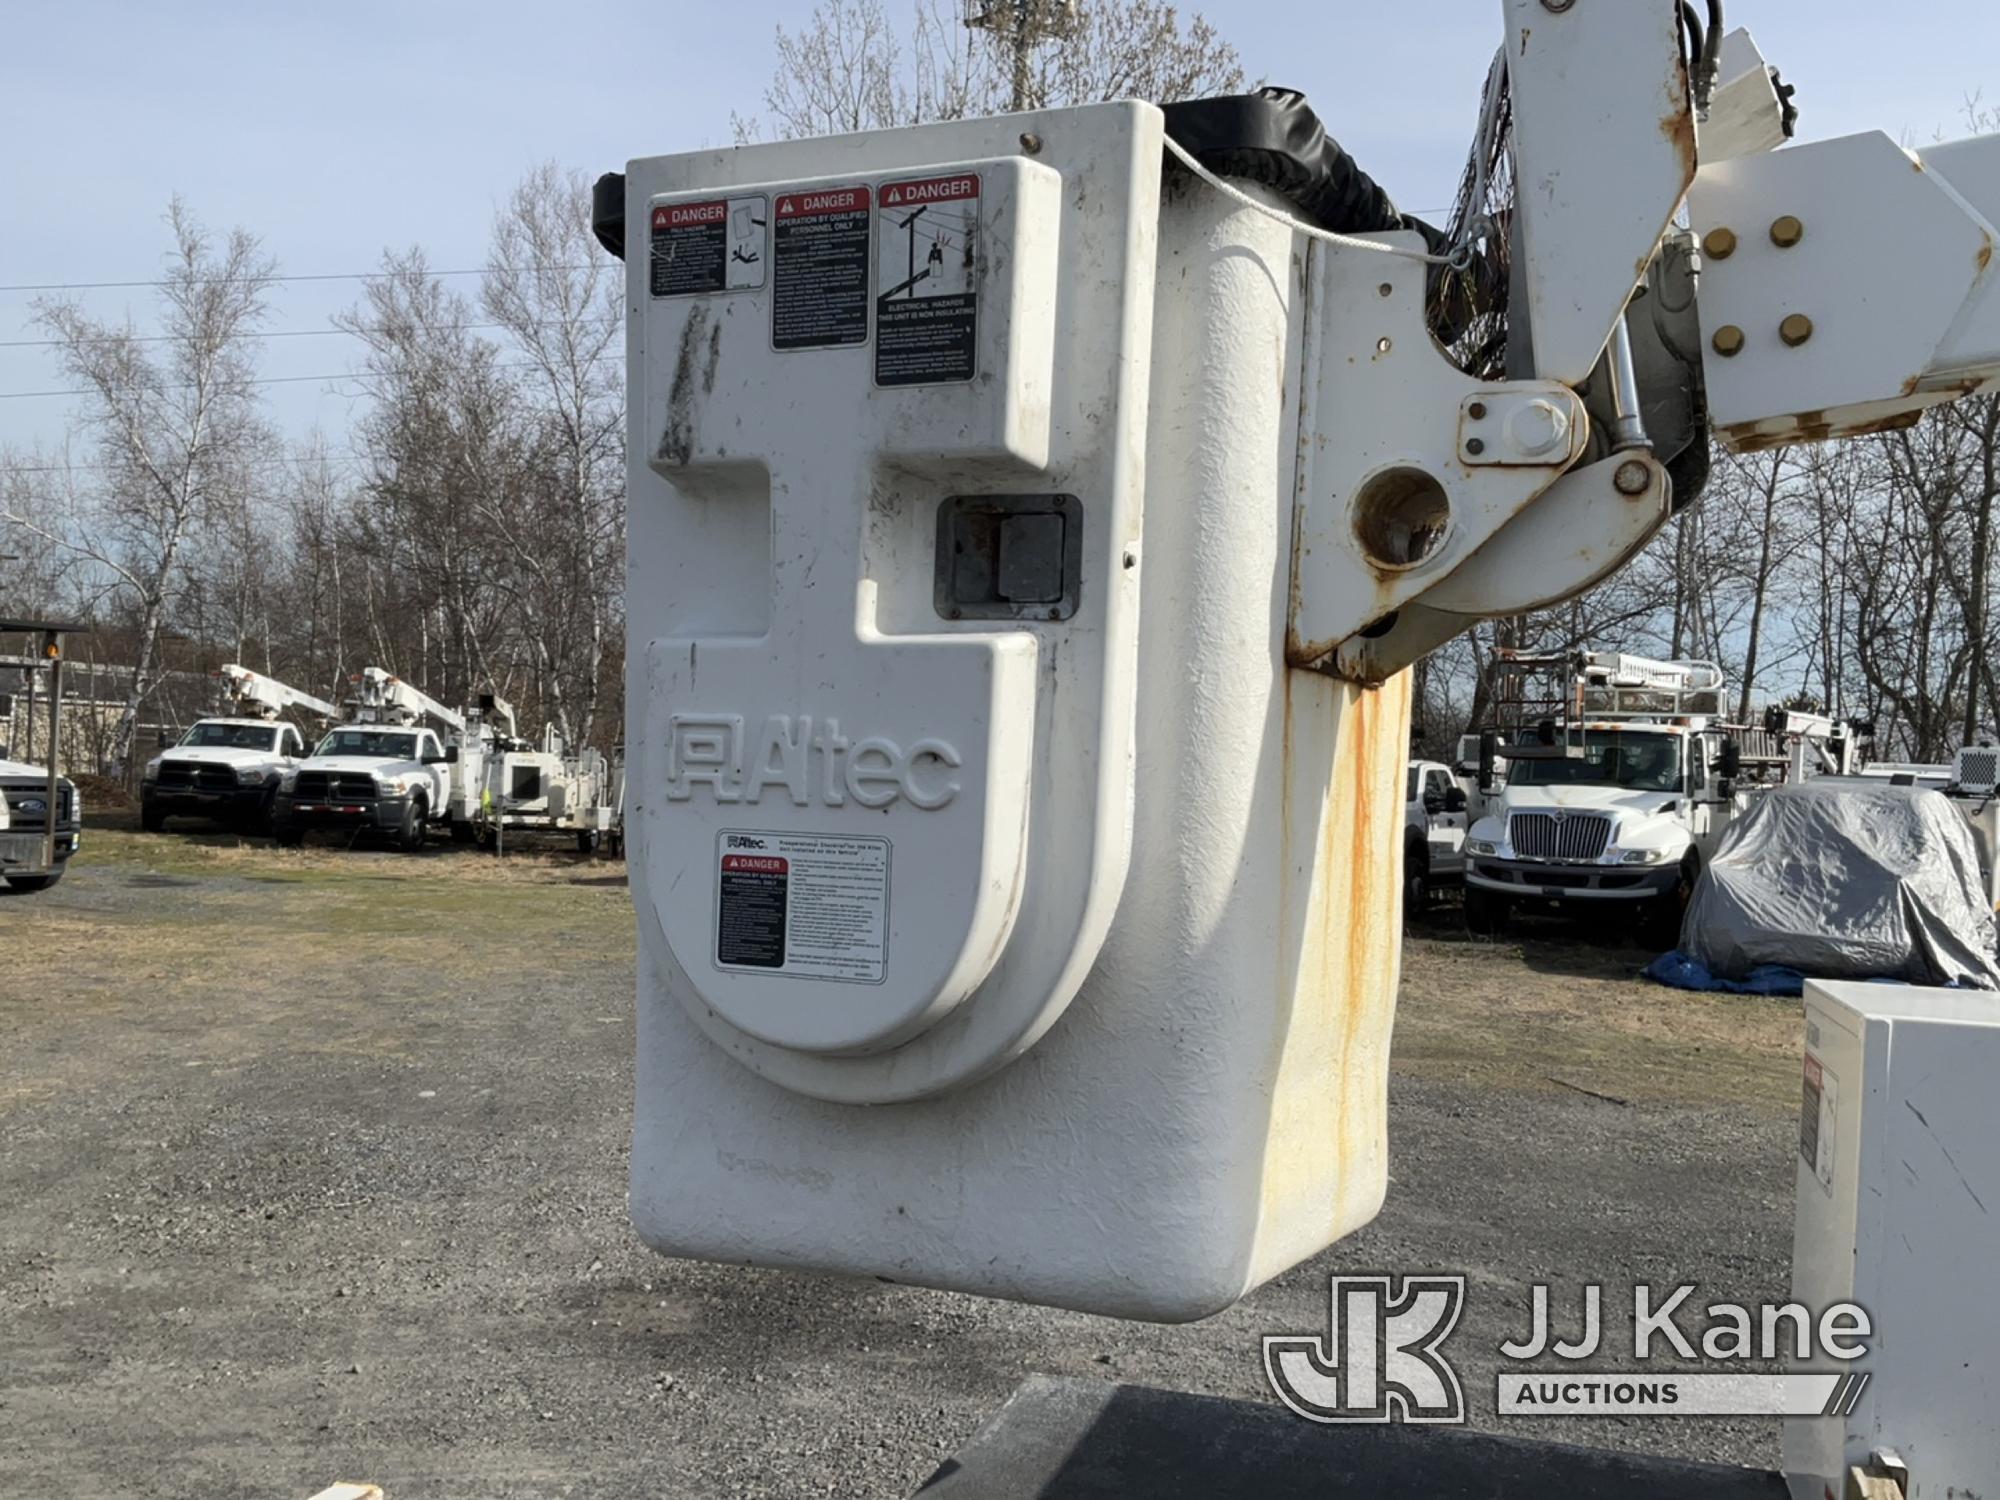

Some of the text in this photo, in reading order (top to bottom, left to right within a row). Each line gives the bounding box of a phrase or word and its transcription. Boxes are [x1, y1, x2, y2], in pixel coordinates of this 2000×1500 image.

[906, 180, 971, 200] DANGER
[803, 193, 854, 210] DANGER
[671, 205, 724, 223] DANGER
[776, 216, 818, 227] OPERATION
[818, 214, 829, 224] BY
[790, 221, 854, 235] PERSONNEL ONLY
[888, 302, 929, 312] ELECTRICAL
[746, 714, 961, 811] Altec
[740, 858, 780, 869] DANGER
